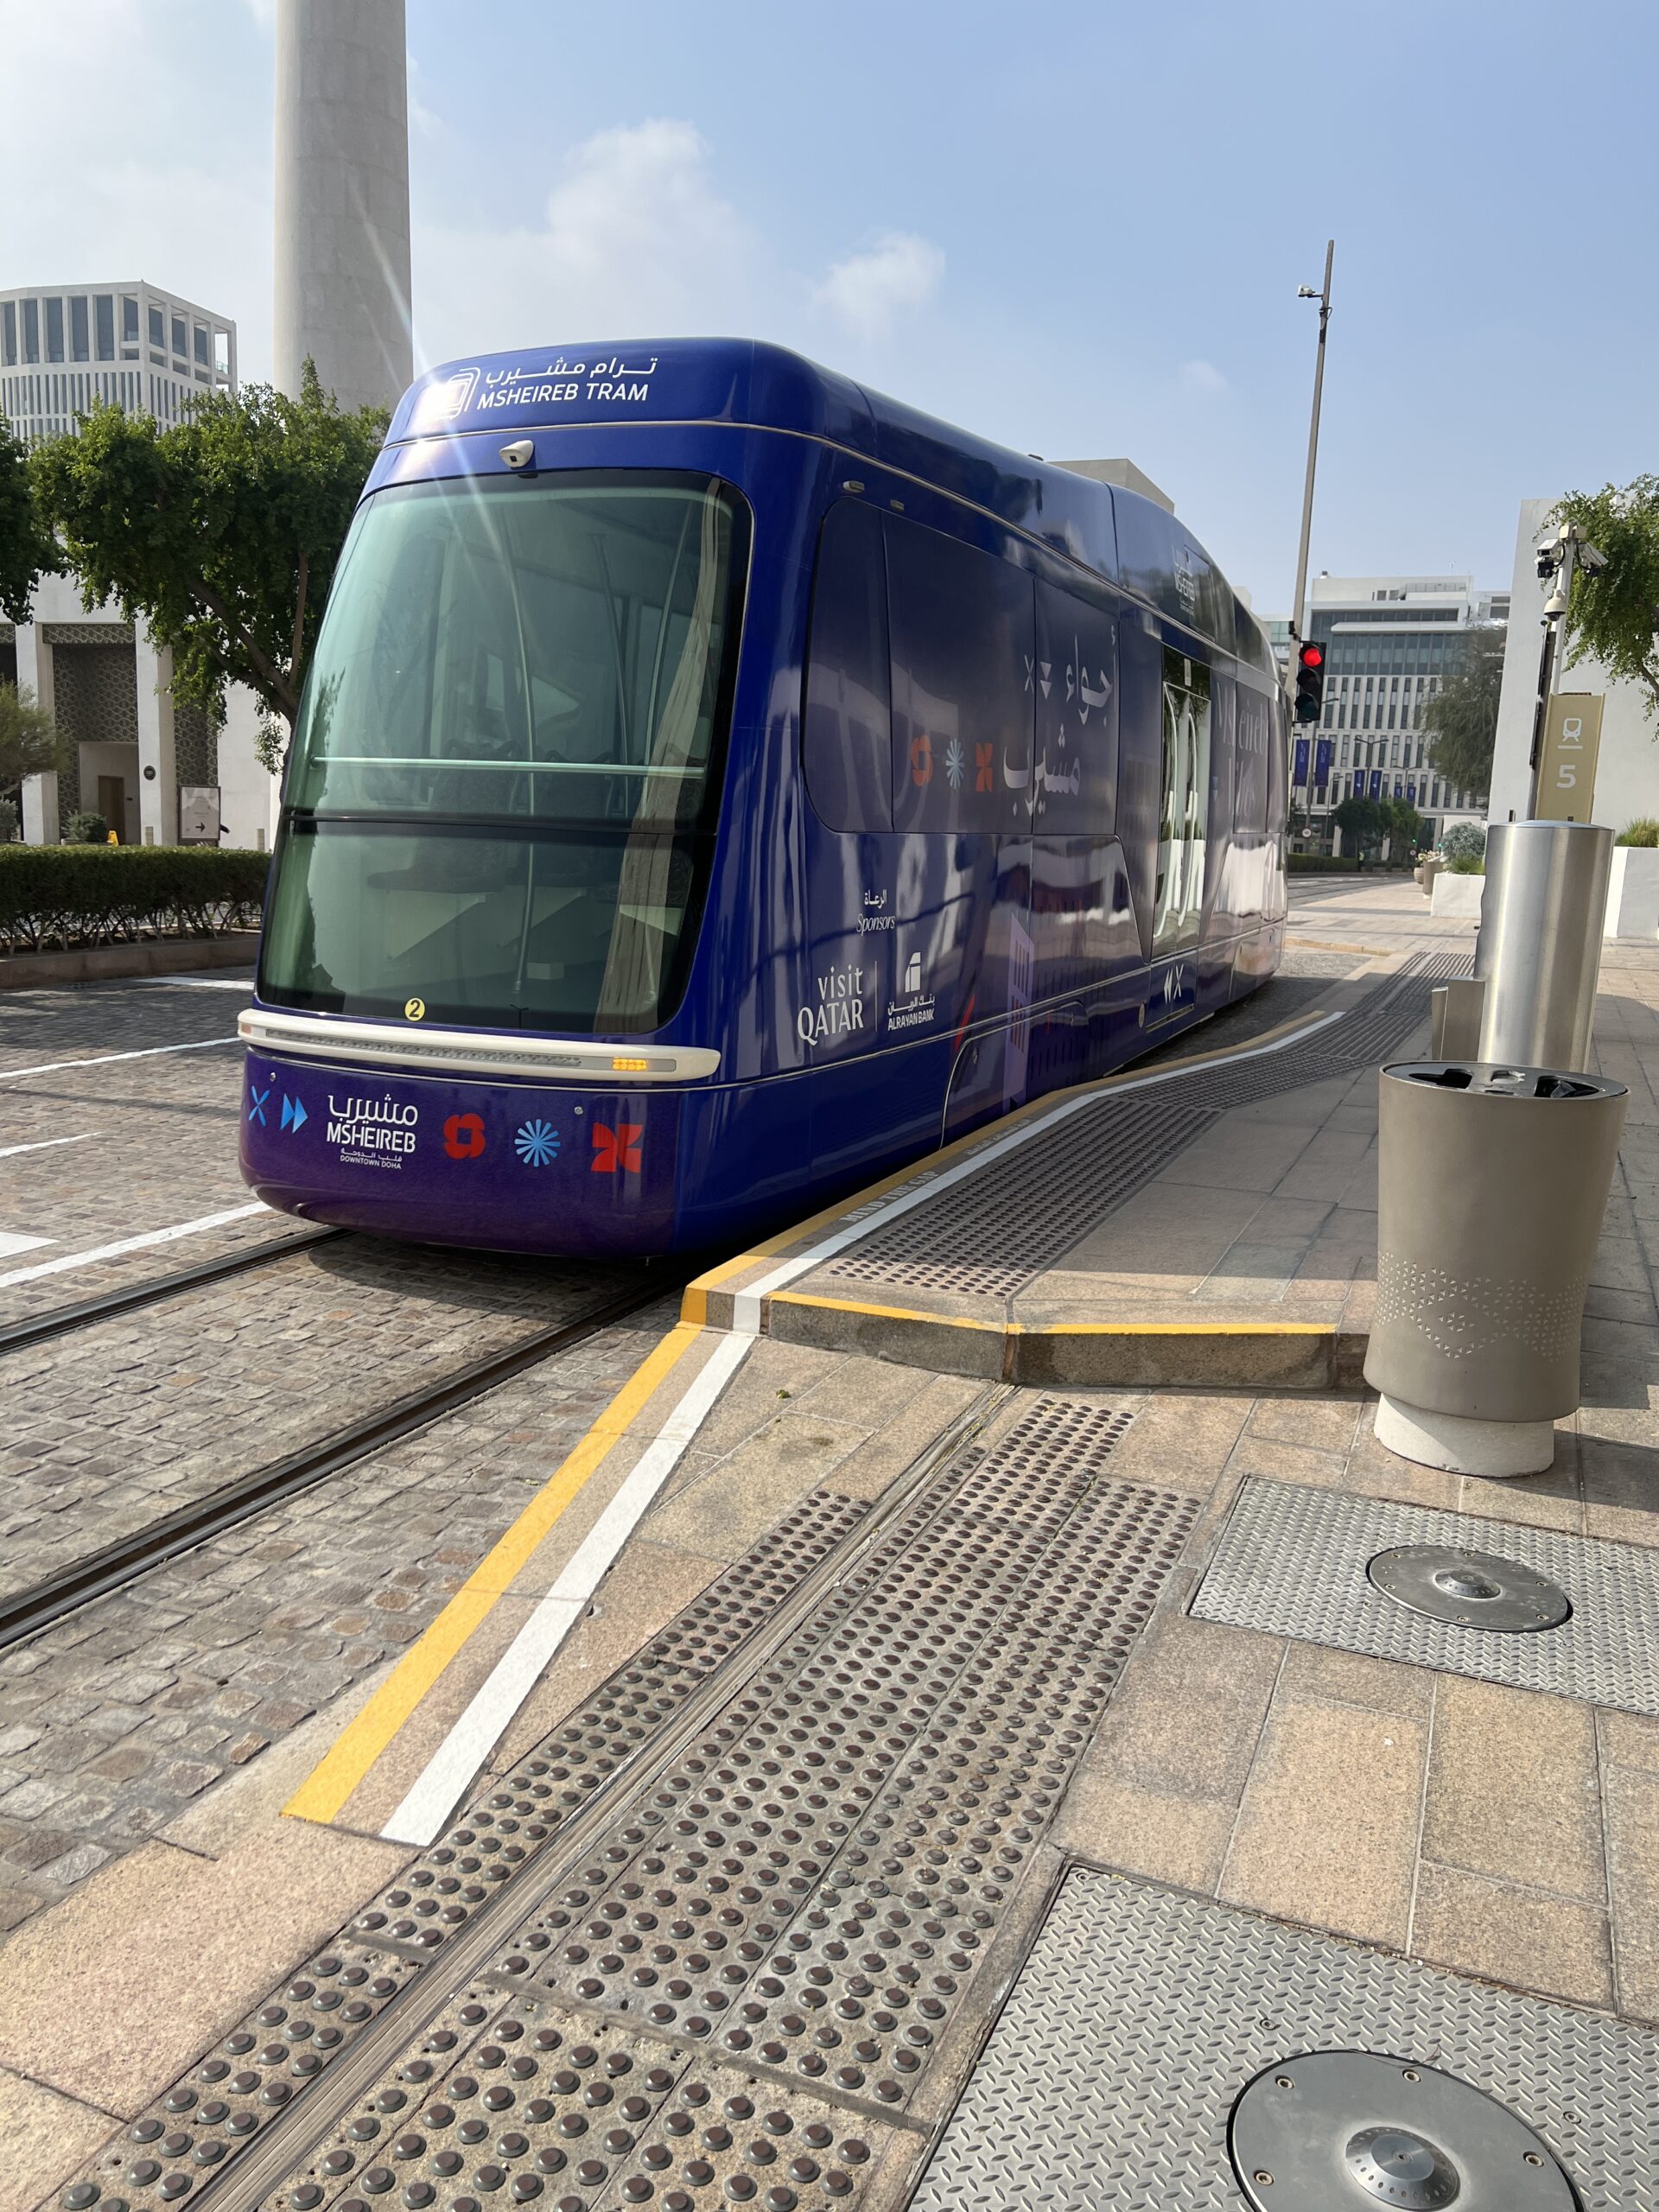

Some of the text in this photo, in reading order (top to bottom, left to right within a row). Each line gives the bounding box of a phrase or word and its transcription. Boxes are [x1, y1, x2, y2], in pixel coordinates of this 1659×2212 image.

[486, 356, 658, 388] ترام مشيرب
[477, 383, 649, 410] MSHEIREB TRAM
[1556, 765, 1577, 788] 5
[864, 889, 887, 909] الرعاة
[856, 913, 896, 936] Sponsors
[817, 963, 863, 1001] visit
[409, 999, 421, 1018] 2
[887, 1007, 935, 1032] ALRAYAN BANK
[798, 999, 864, 1046] QATAR
[327, 1093, 418, 1126] مشيرب
[327, 1122, 416, 1154] MSHEIREB
[340, 1154, 402, 1170] DOWNTOWN DOHA
